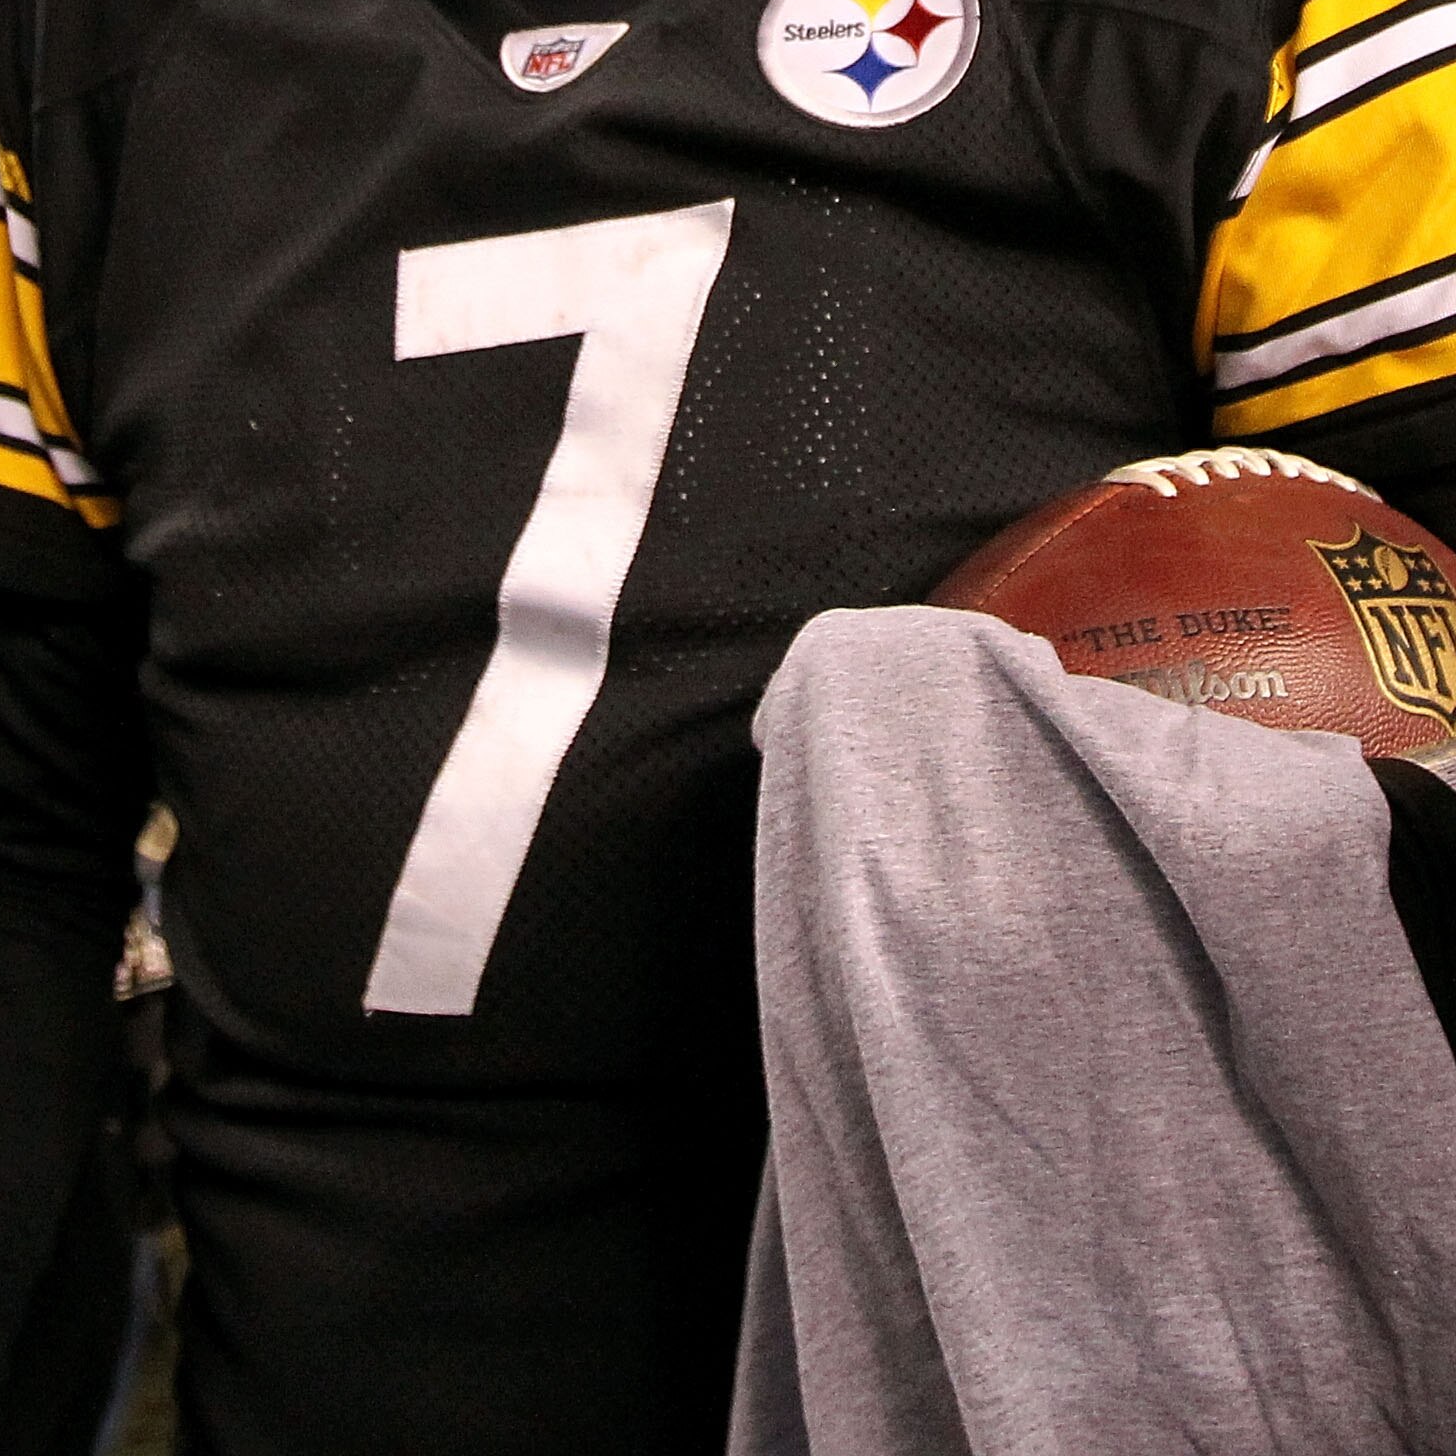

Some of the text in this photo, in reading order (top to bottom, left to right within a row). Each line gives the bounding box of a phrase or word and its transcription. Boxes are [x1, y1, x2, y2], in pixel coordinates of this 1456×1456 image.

[784, 19, 865, 42] Steelers
[527, 52, 572, 75] NFL
[362, 198, 736, 1016] 7
